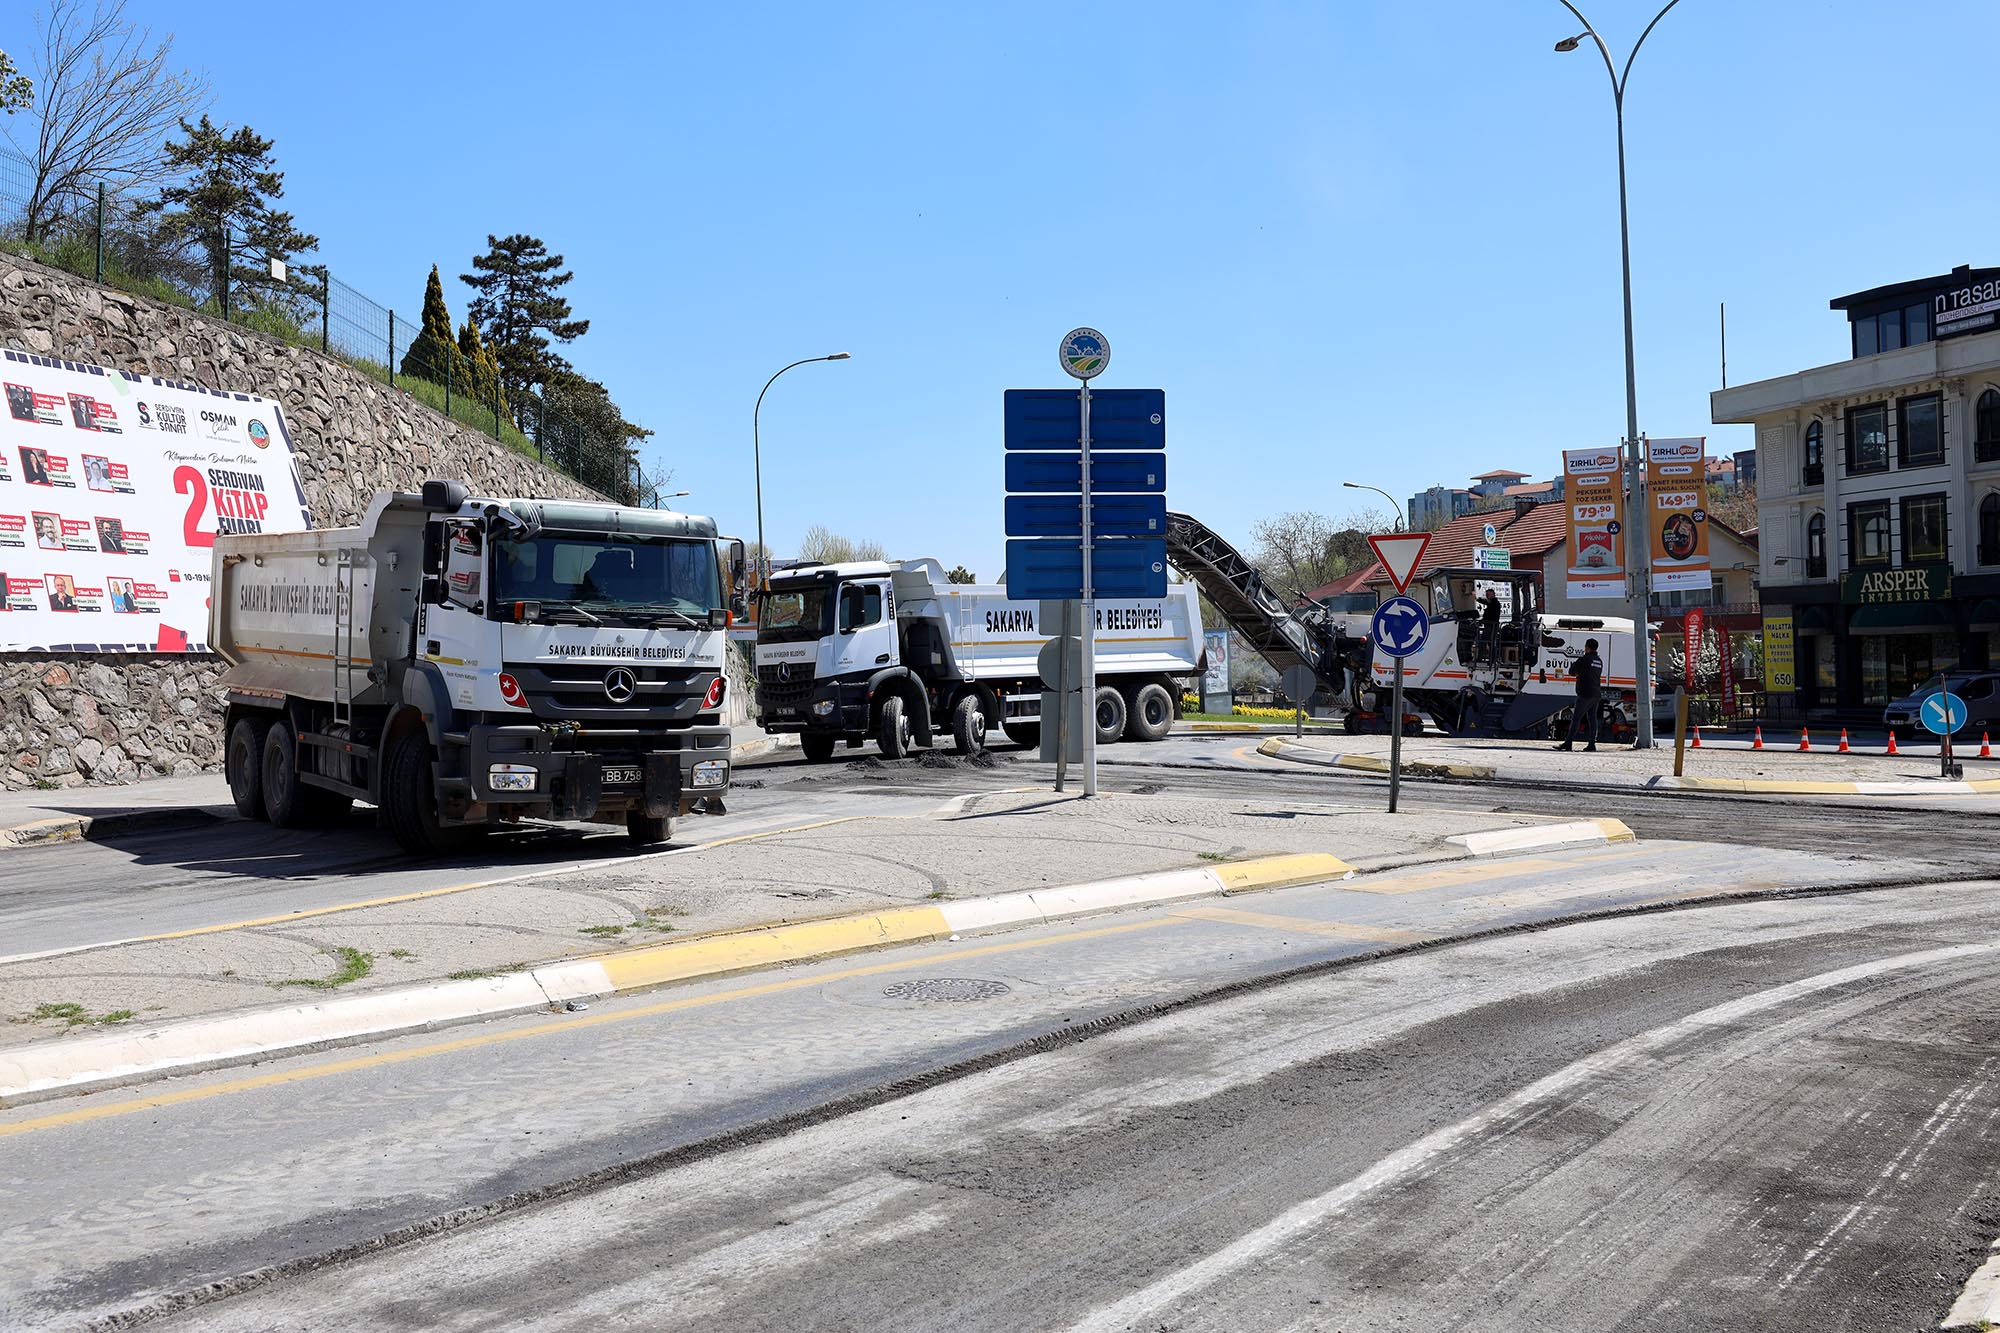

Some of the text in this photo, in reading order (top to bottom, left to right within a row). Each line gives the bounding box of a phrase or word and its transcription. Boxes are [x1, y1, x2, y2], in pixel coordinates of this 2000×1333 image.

[156, 412, 186, 424] KÜLTÜR
[200, 410, 236, 426] OSMAN
[160, 422, 187, 434] SANAT
[1570, 459, 1596, 467] ZIRHLI
[173, 464, 216, 548] 2
[184, 574, 202, 582] 10-19
[1860, 569, 1929, 592] ARSPER
[240, 577, 349, 618] SAKARYA BÜYÜKŞEHİR BELEDİES
[1860, 591, 1930, 603] INTERIOR
[986, 610, 1034, 633] SAKARYA
[1107, 603, 1162, 630] BELEDİYESİ
[549, 645, 586, 656] SAKARYA
[590, 644, 640, 658] BÜYÜKŞEHİR
[642, 645, 686, 659] BELEDİYESİ
[606, 771, 642, 781] BB 758
